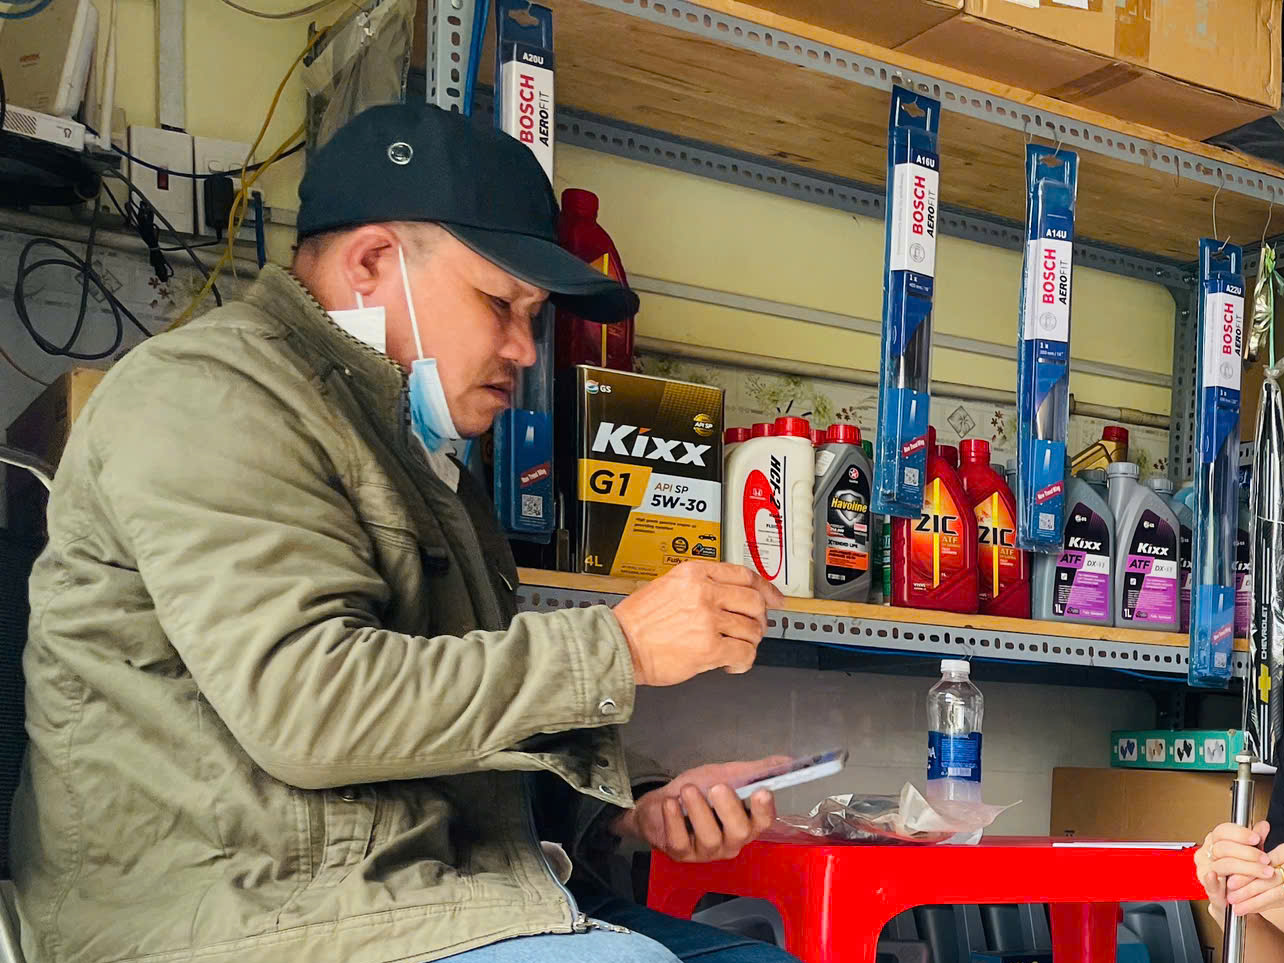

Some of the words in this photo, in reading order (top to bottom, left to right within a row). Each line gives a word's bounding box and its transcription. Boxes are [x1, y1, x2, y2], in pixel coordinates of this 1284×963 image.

[522, 52, 545, 66] A20U
[519, 73, 535, 145] BOSCH
[538, 90, 551, 147] AEROFIT
[916, 154, 936, 169] A16U
[912, 175, 926, 236] BOSCH
[926, 190, 937, 238] AEROFIT
[1046, 228, 1068, 240] A14U
[1042, 248, 1057, 305] BOSCH
[1058, 260, 1070, 306] AEROFIT
[1222, 302, 1234, 355] BOSCH
[1234, 314, 1242, 357] AEROFIT
[600, 385, 612, 394] GS
[591, 421, 712, 467] Kixx
[589, 469, 631, 497] G1
[654, 482, 673, 492] API
[675, 484, 689, 494] SP
[769, 454, 781, 508] HCF-2
[650, 495, 707, 513] 5W-30
[831, 496, 868, 513] Havoline
[914, 513, 958, 535] ZIC
[942, 535, 958, 543] ATF
[979, 525, 1014, 548] ZIC
[1068, 536, 1102, 551] Kixx
[1000, 548, 1014, 556] ATF
[1137, 542, 1169, 556] Kixx
[584, 554, 603, 568] 4L
[1060, 553, 1082, 565] ATF
[1129, 559, 1151, 570] ATF
[1055, 603, 1064, 614] 1L
[1124, 608, 1132, 618] 1L
[1261, 605, 1269, 660] CHEVROLET
